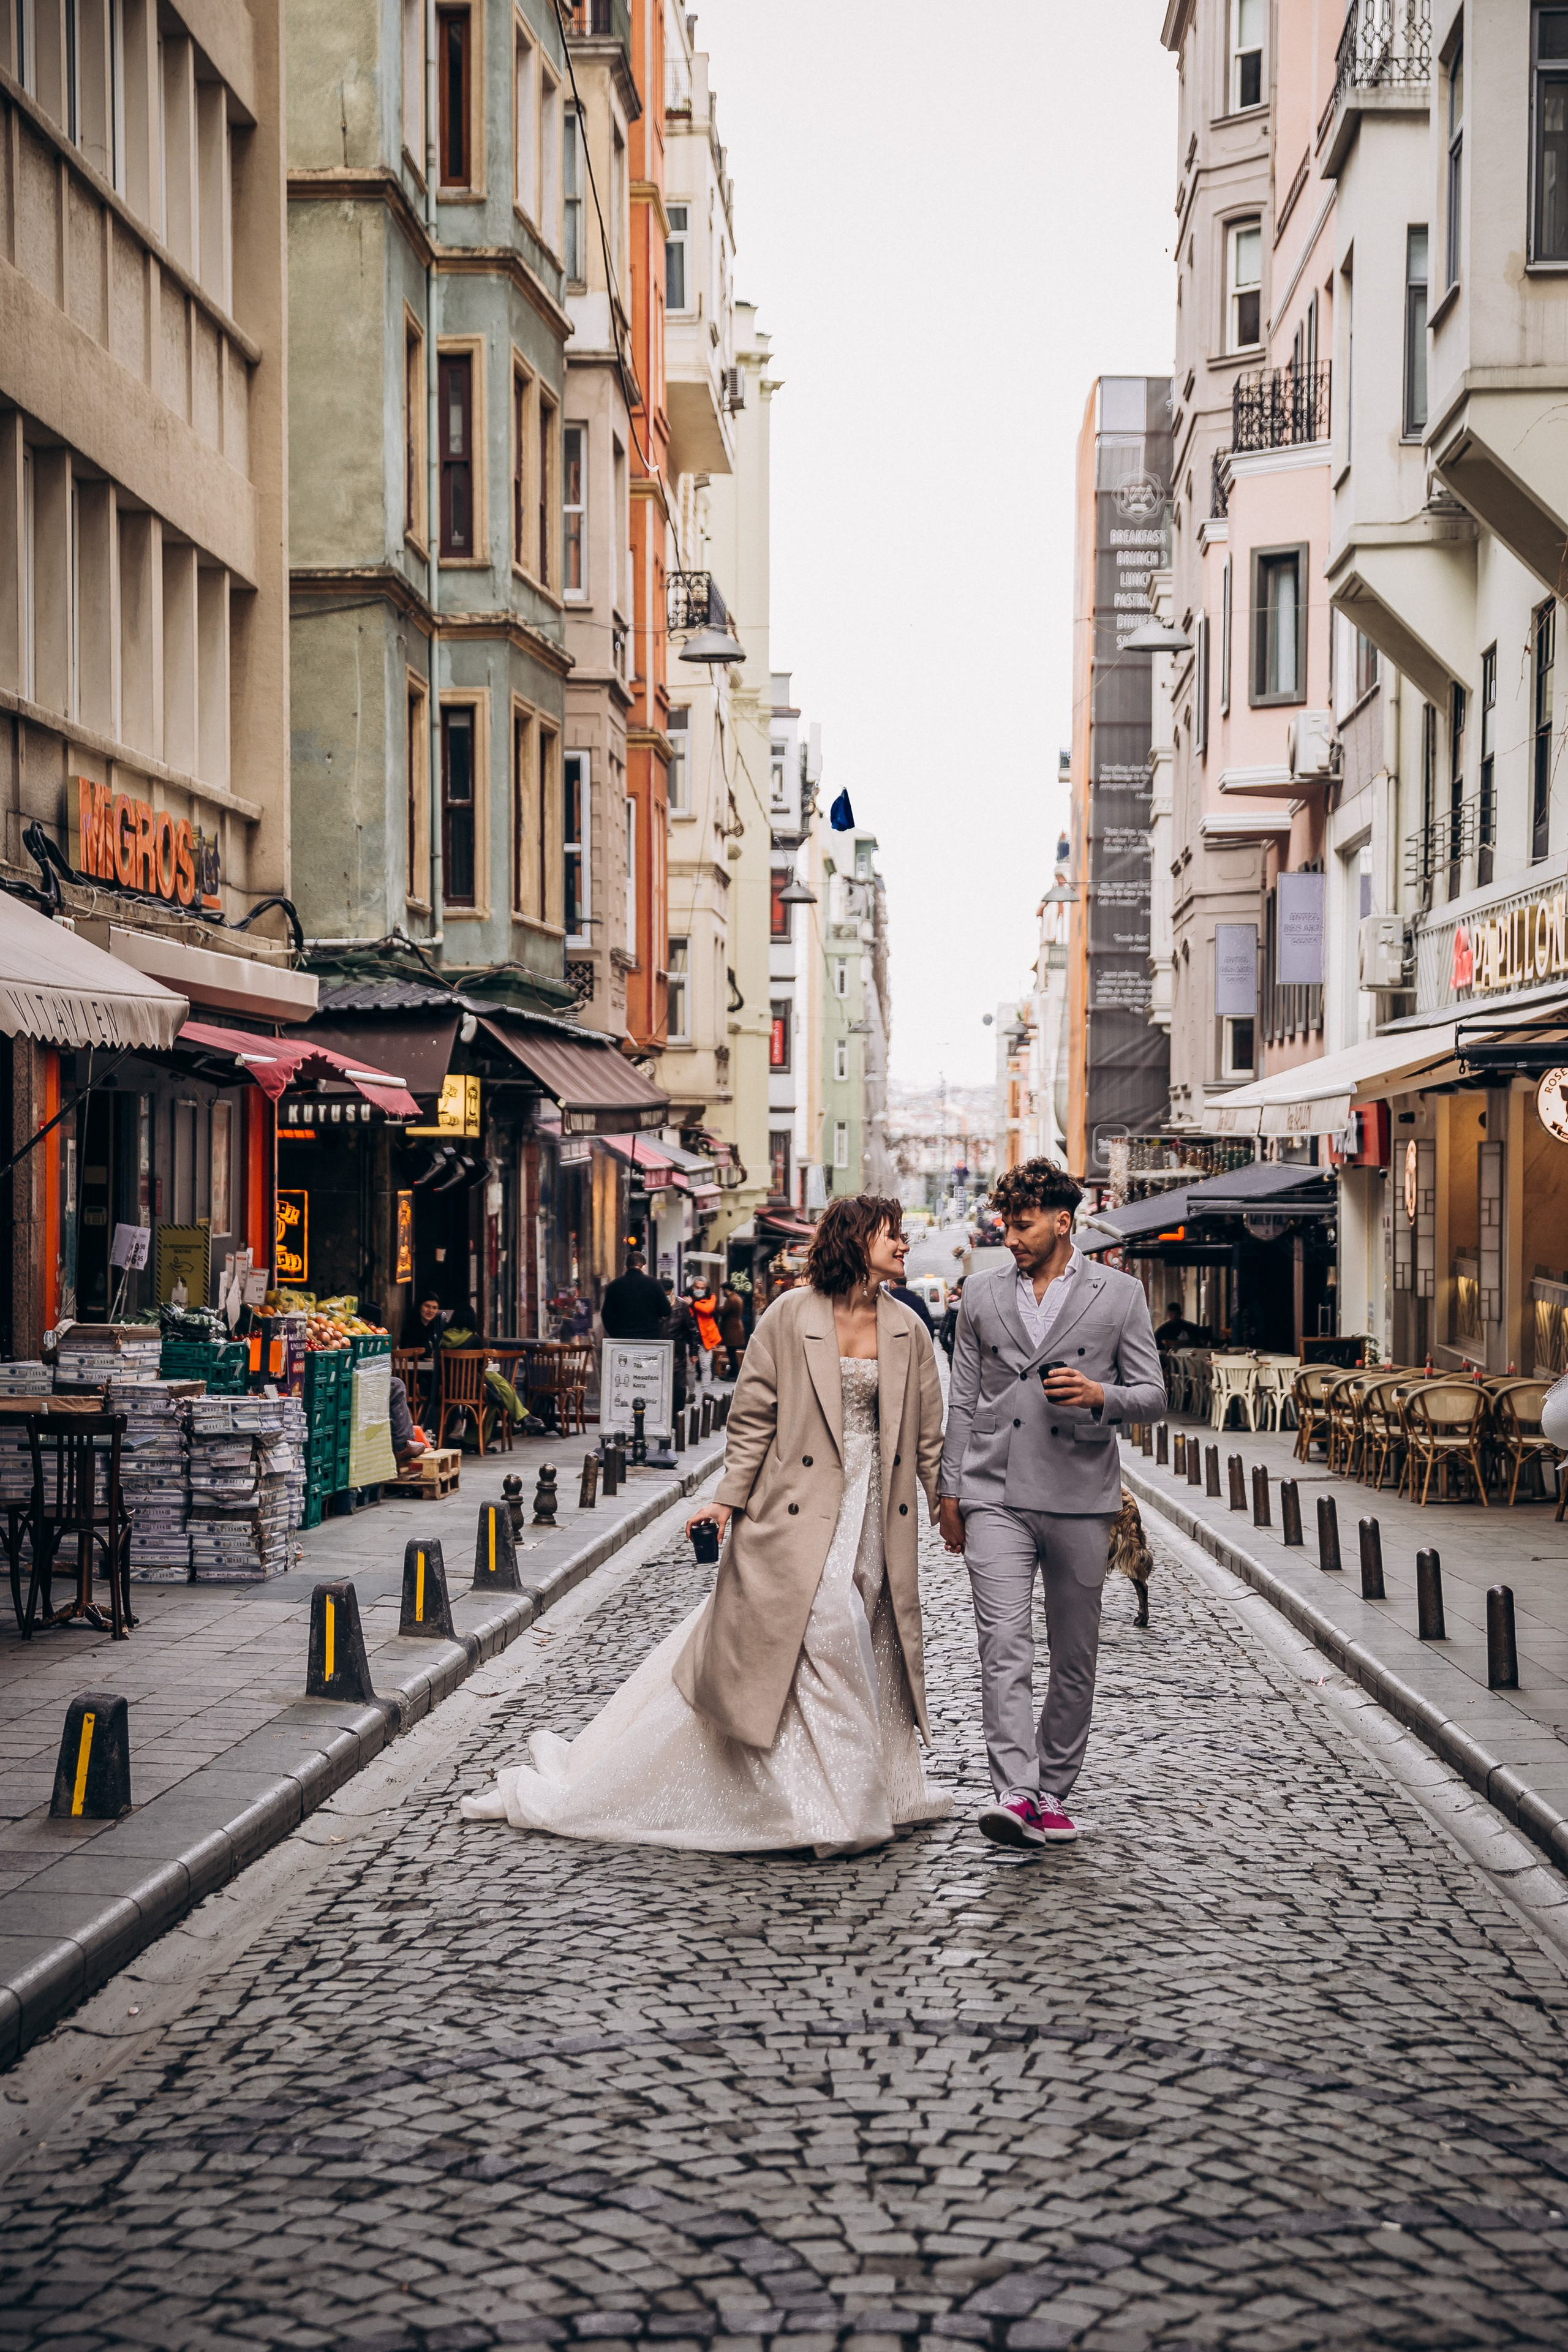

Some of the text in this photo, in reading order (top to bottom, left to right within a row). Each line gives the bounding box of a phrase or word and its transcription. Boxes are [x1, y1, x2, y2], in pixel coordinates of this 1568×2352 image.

[1110, 529, 1167, 545] BREAKFAST
[1117, 551, 1159, 567] BRUNCH
[1472, 891, 1567, 992] PAPILLON
[6, 989, 119, 1040] VITAVIEN
[288, 1104, 371, 1123] KUTUSU
